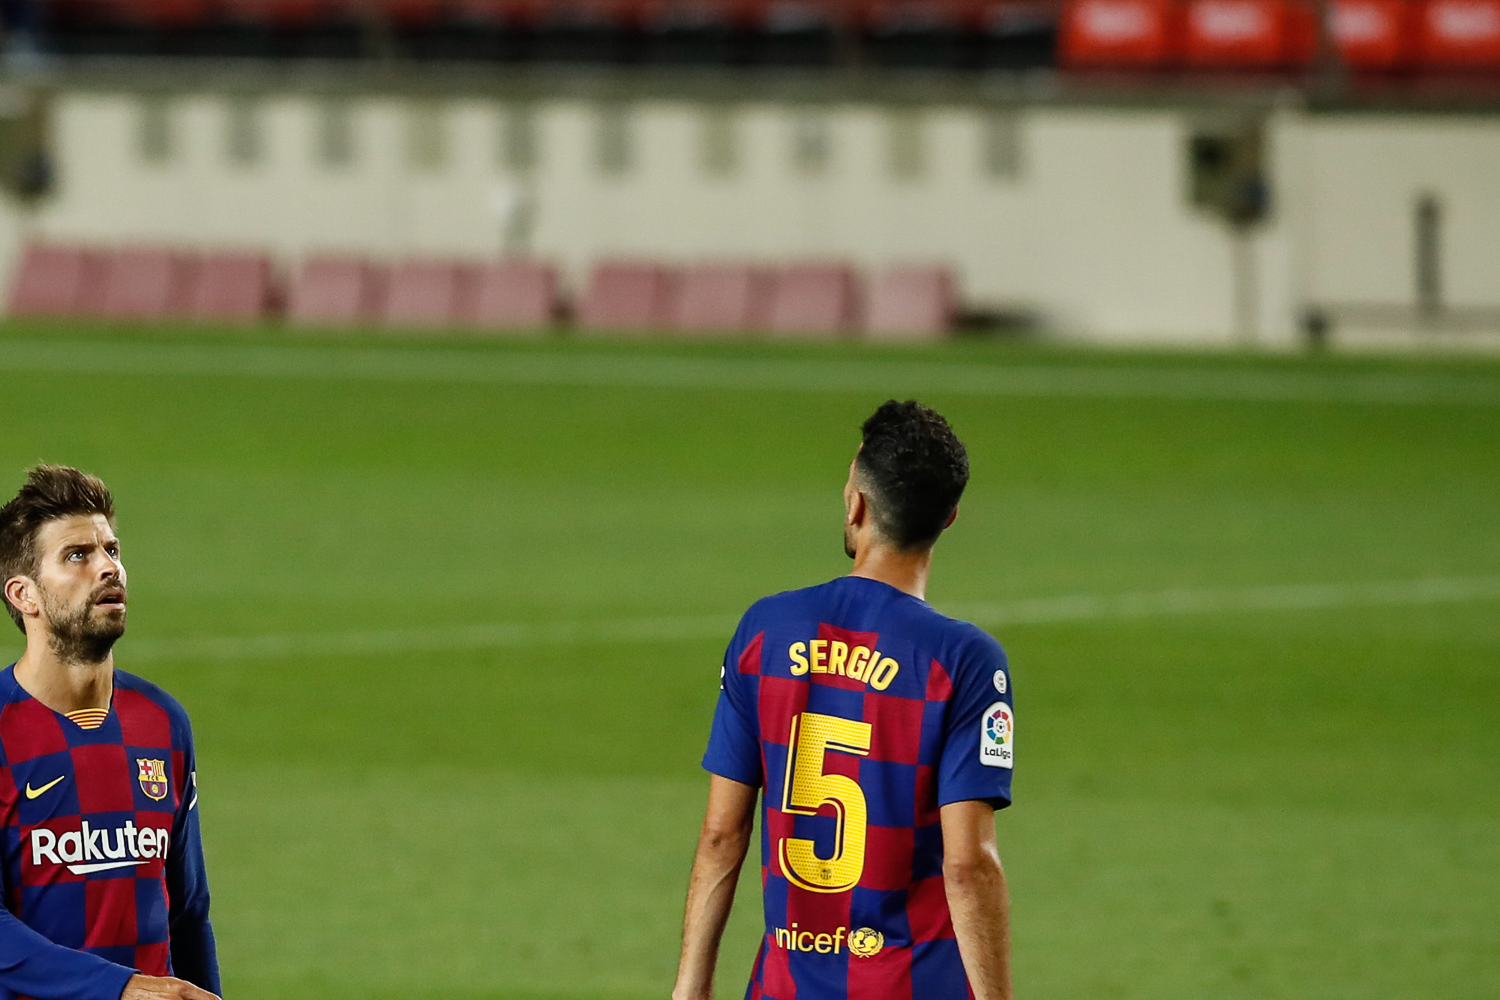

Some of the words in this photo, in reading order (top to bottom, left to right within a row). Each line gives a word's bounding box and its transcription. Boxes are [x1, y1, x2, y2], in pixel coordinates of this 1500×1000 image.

[788, 639, 900, 691] SERGIO
[778, 711, 873, 894] 5
[31, 820, 169, 865] Rakuten
